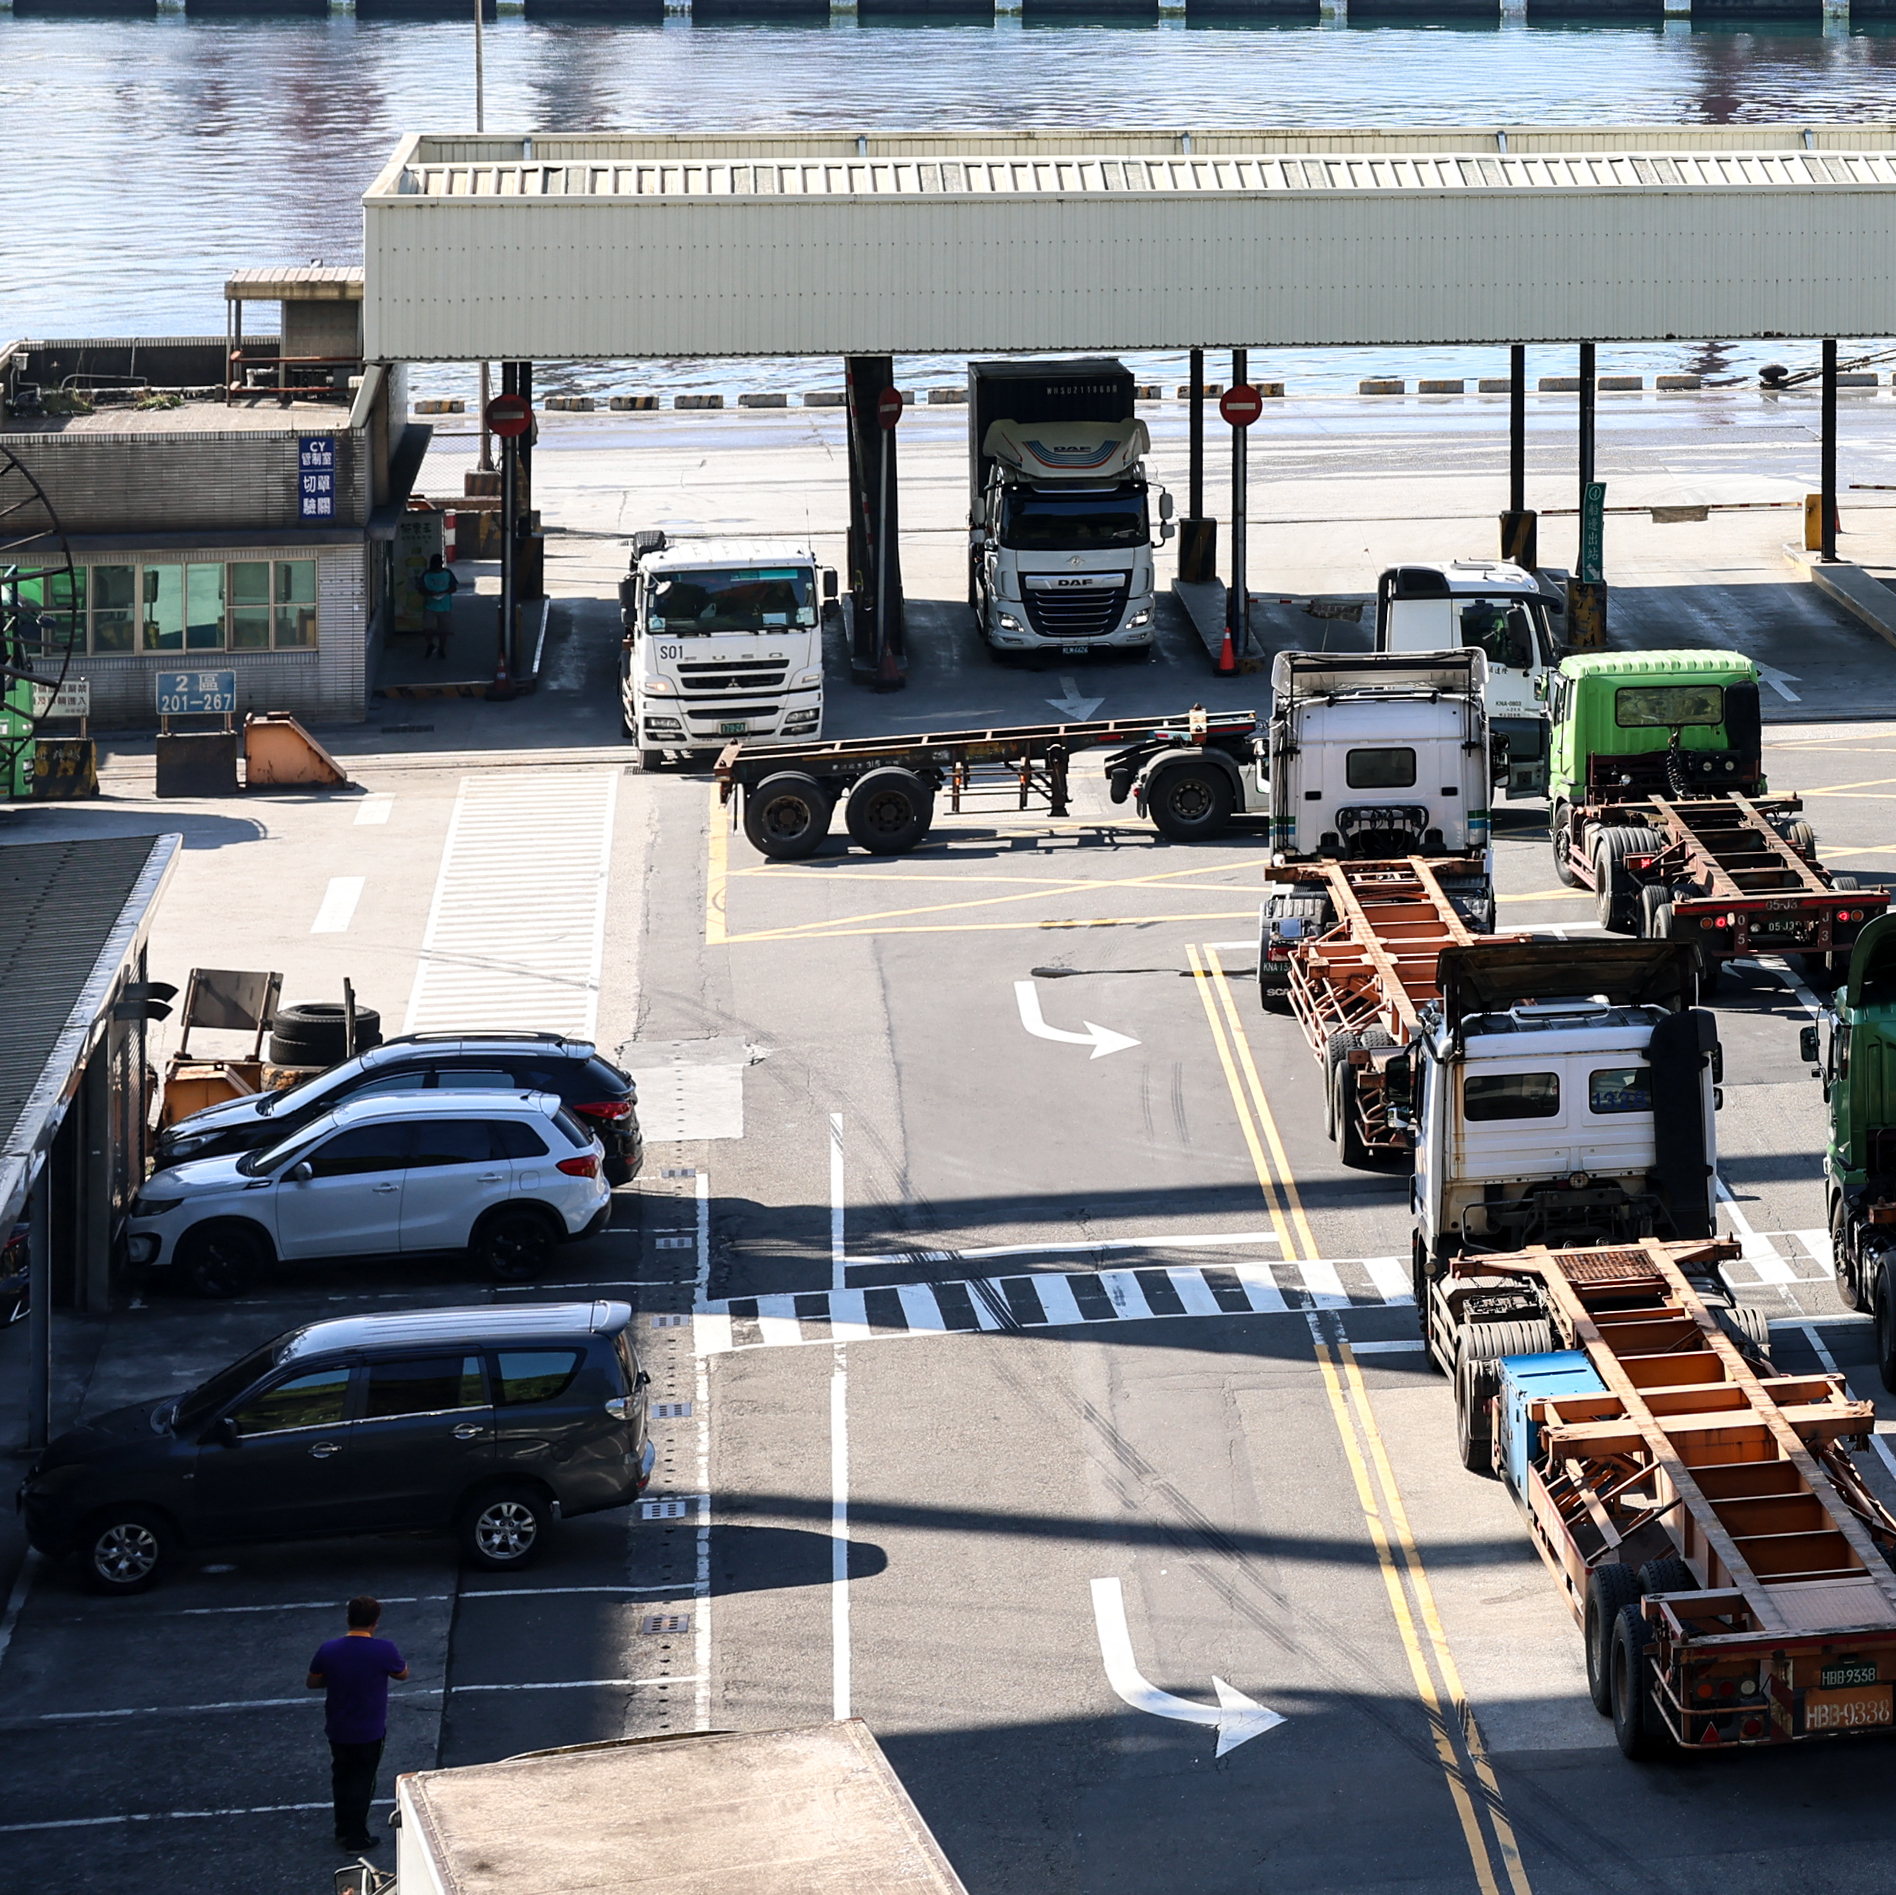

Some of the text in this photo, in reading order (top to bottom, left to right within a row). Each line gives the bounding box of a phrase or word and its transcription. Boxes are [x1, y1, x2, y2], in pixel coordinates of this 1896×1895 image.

[309, 441, 326, 452] CY
[301, 451, 332, 466] 管制室
[303, 475, 331, 493] 切單
[302, 497, 331, 515] 驗關
[1058, 578, 1094, 587] DAF
[660, 645, 684, 660] S01
[175, 674, 219, 693] 2 區
[1821, 1667, 1877, 1687] HBB-9338
[1806, 1699, 1891, 1729] HBB-9338
